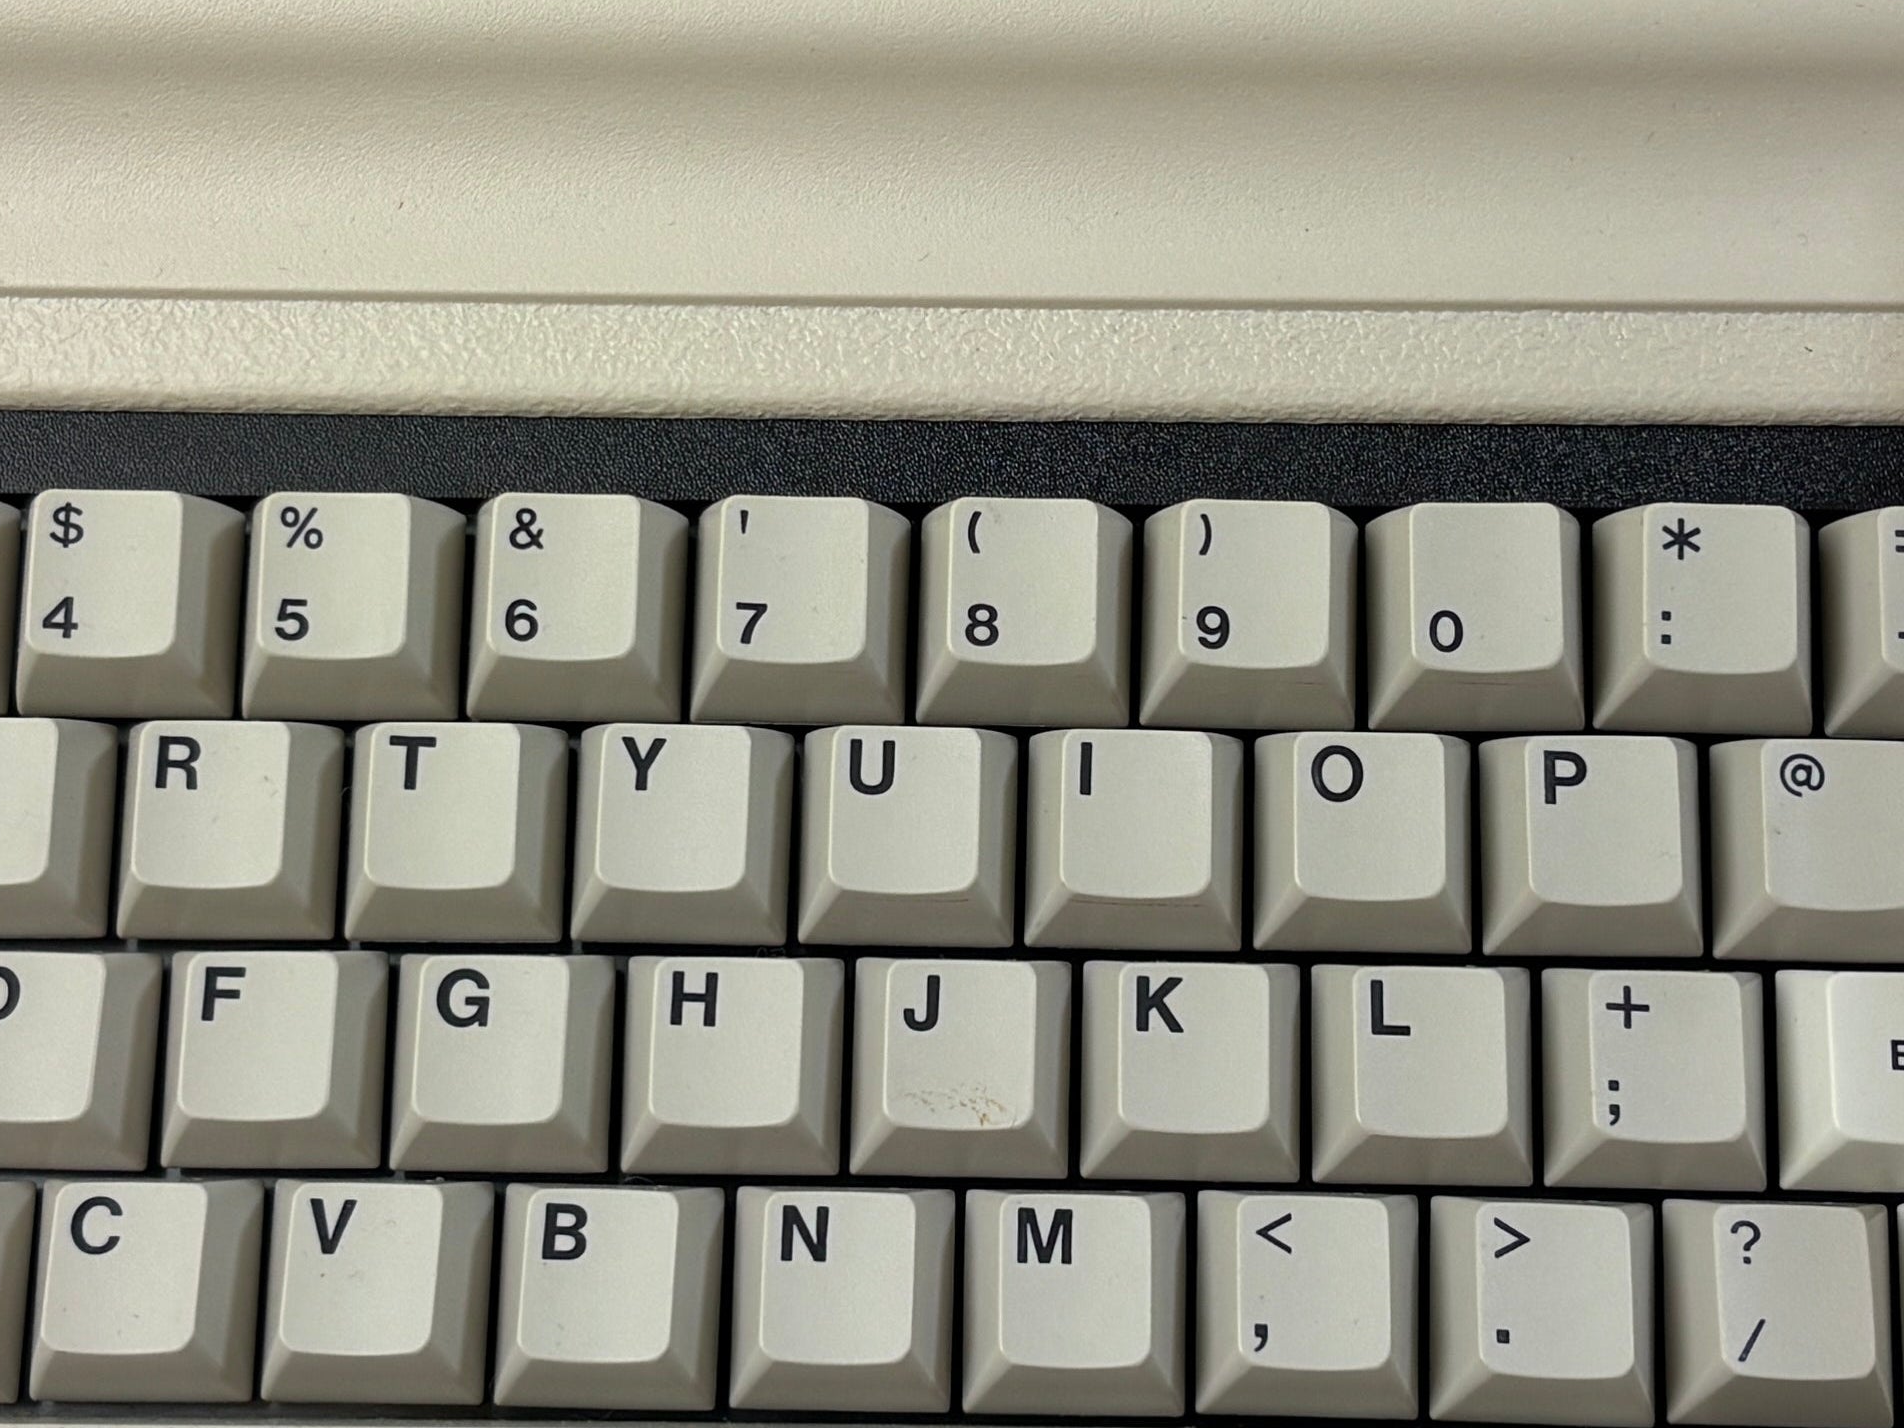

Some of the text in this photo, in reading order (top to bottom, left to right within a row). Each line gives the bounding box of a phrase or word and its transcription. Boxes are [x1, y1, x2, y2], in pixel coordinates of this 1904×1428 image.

[49, 502, 84, 549] $
[280, 506, 323, 550] %
[509, 507, 544, 550] &
[740, 509, 749, 534] '
[967, 510, 982, 554] (
[1199, 513, 1212, 556] )
[42, 596, 79, 639] 4
[274, 598, 309, 641] 5
[504, 598, 539, 642] 6
[735, 601, 768, 645] 7
[964, 603, 999, 647] 8
[1196, 605, 1230, 650] 9
[1429, 609, 1464, 653] 0
[1660, 610, 1672, 645] :
[154, 735, 201, 790] R
[389, 735, 437, 791] T
[621, 736, 667, 791] Y
[849, 738, 896, 796] U
[1079, 741, 1093, 796] I
[1310, 744, 1364, 803] O
[1543, 749, 1588, 805] P
[1779, 753, 1825, 798] @
[201, 966, 246, 1022] F
[436, 968, 490, 1028] G
[670, 970, 719, 1027] H
[903, 974, 941, 1032] J
[1135, 975, 1184, 1034] K
[1370, 979, 1411, 1037] L
[1605, 985, 1650, 1030] +
[1608, 1079, 1621, 1126] ;
[70, 1196, 123, 1255] C
[309, 1198, 357, 1255] V
[541, 1202, 588, 1261] B
[780, 1204, 830, 1263] N
[1016, 1207, 1073, 1265] M
[1255, 1213, 1292, 1254] <
[1493, 1217, 1531, 1259] >
[1730, 1220, 1761, 1265] ?
[1254, 1323, 1269, 1352] ,
[1496, 1329, 1510, 1344] .
[1738, 1318, 1766, 1363] /
